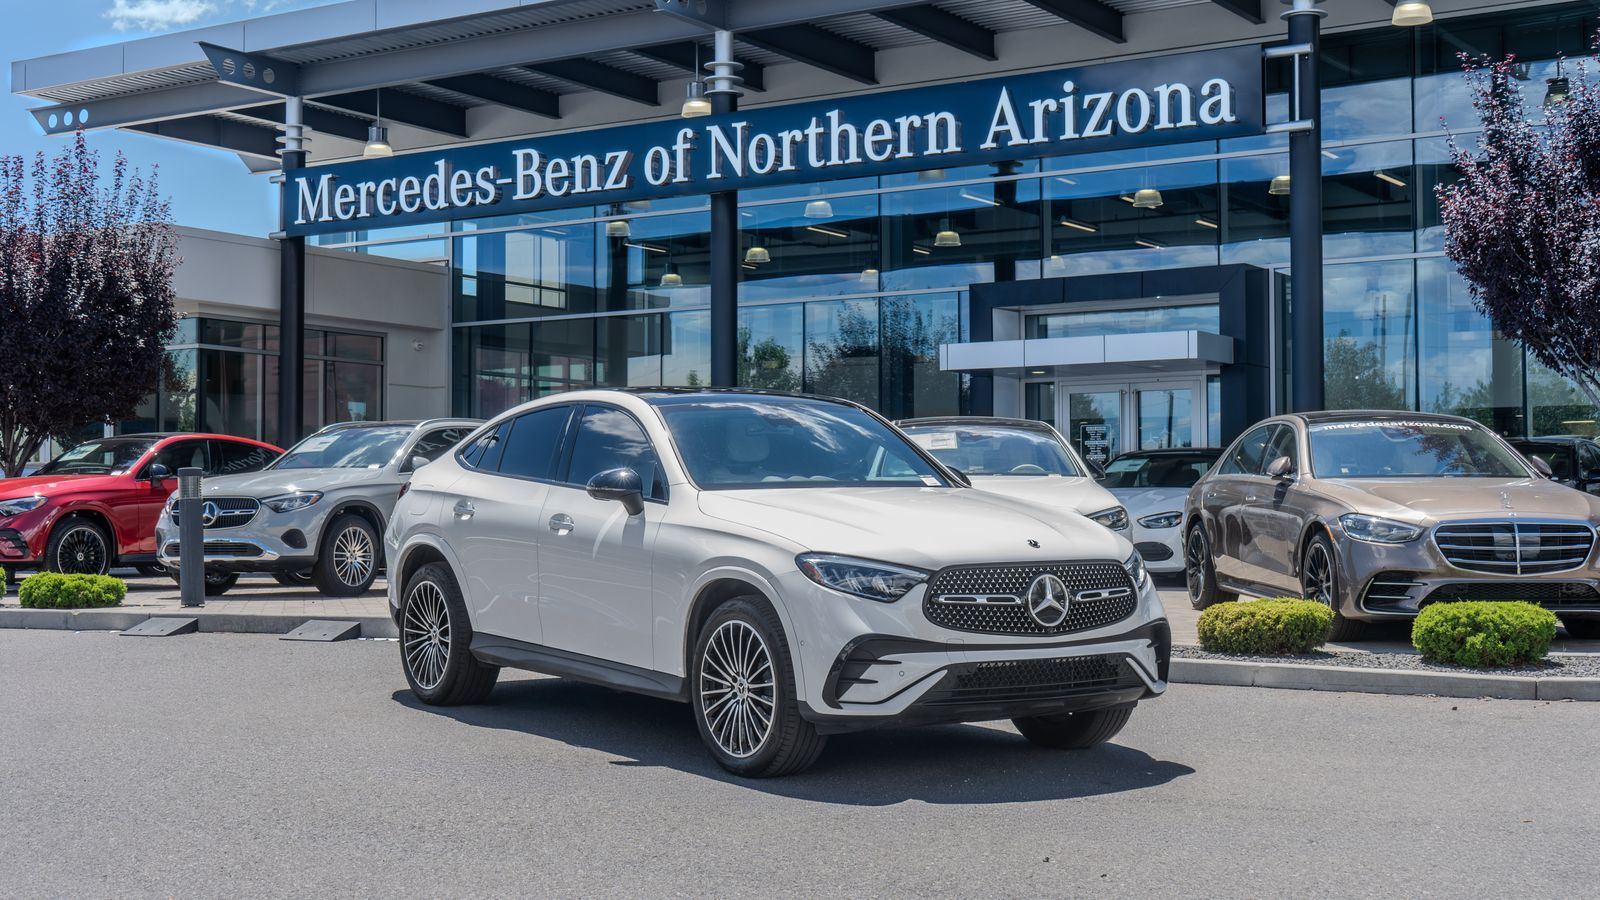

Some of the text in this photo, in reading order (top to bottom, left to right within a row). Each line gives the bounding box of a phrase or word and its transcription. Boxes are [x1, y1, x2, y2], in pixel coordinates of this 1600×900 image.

[294, 80, 1236, 225] Mercedes-Benz of Northern Arizona
[1323, 420, 1473, 431] mercedesarizona.com
